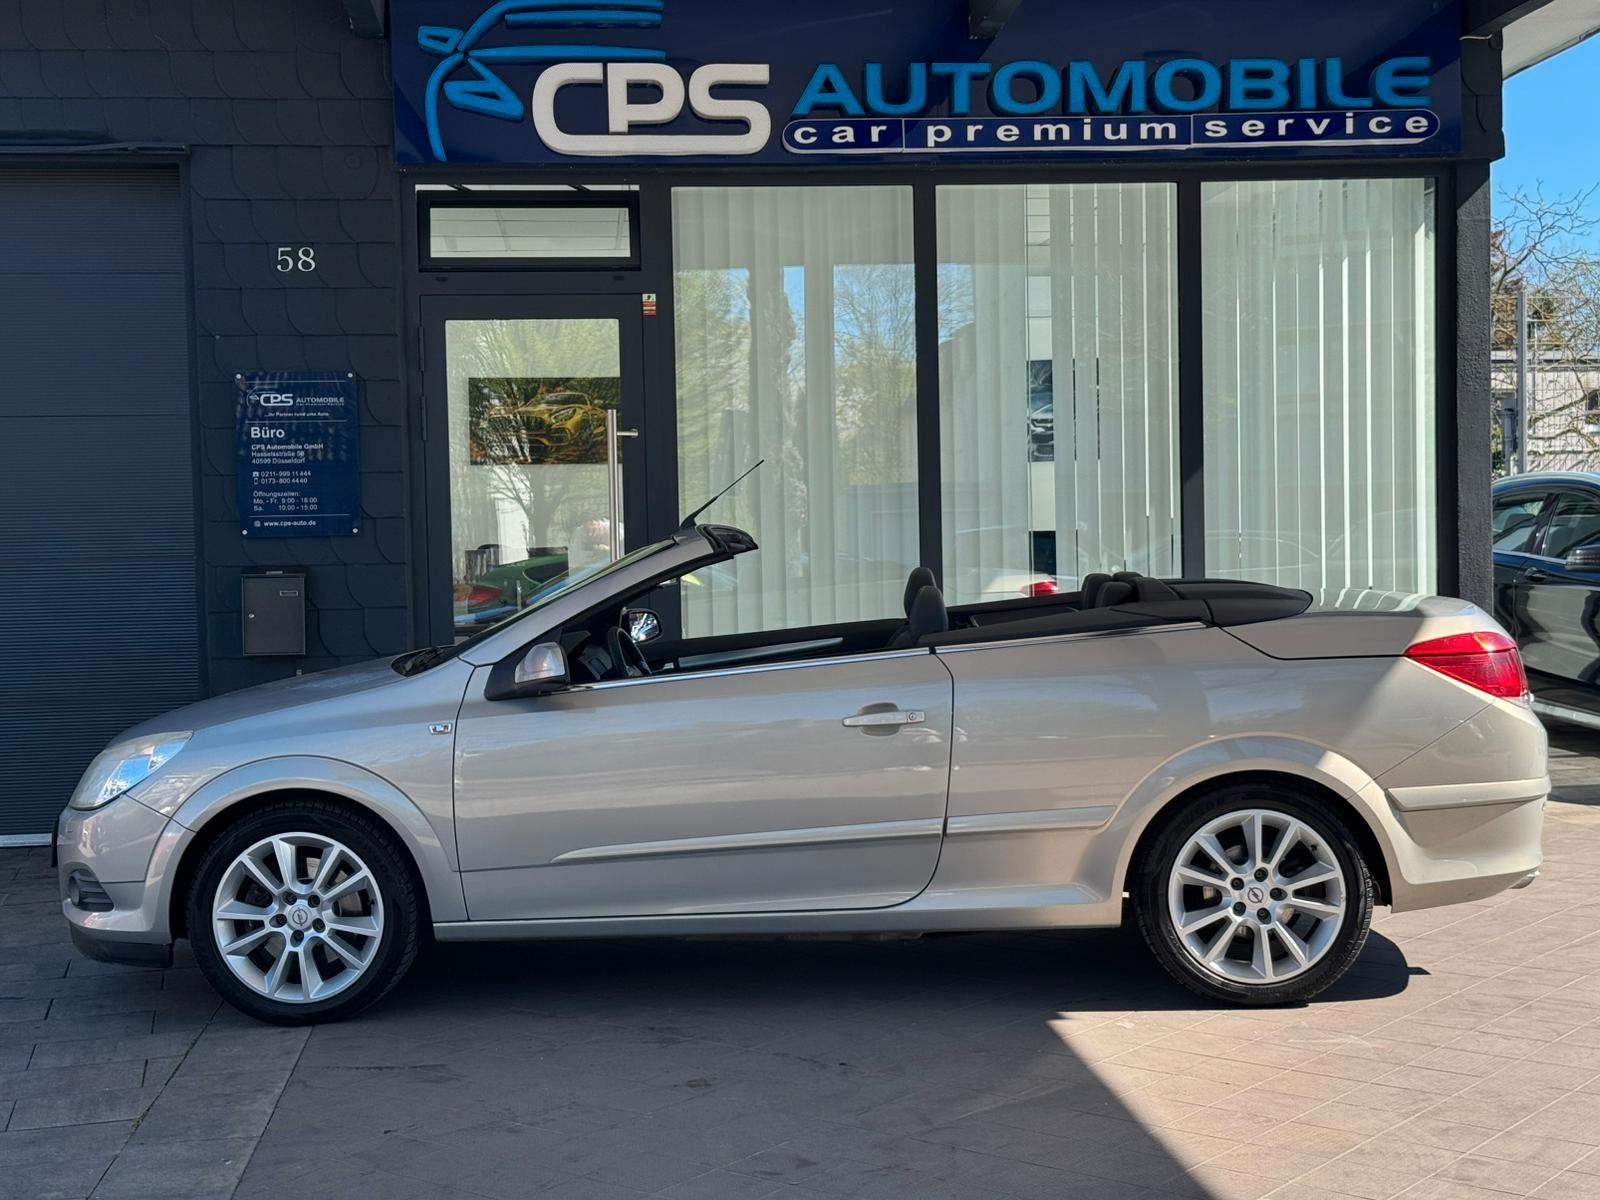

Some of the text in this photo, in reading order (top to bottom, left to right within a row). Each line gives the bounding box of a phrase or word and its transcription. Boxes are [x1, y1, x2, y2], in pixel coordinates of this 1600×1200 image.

[532, 56, 1432, 155] CPS AUTOMOBILE
[793, 112, 1430, 147] car premium service
[276, 246, 316, 272] 58
[260, 393, 294, 407] CPS
[250, 426, 286, 439] Büro
[303, 442, 324, 450] GmbH
[272, 456, 306, 464] Düsseldorf
[263, 519, 317, 527] www.cps-auto.de
